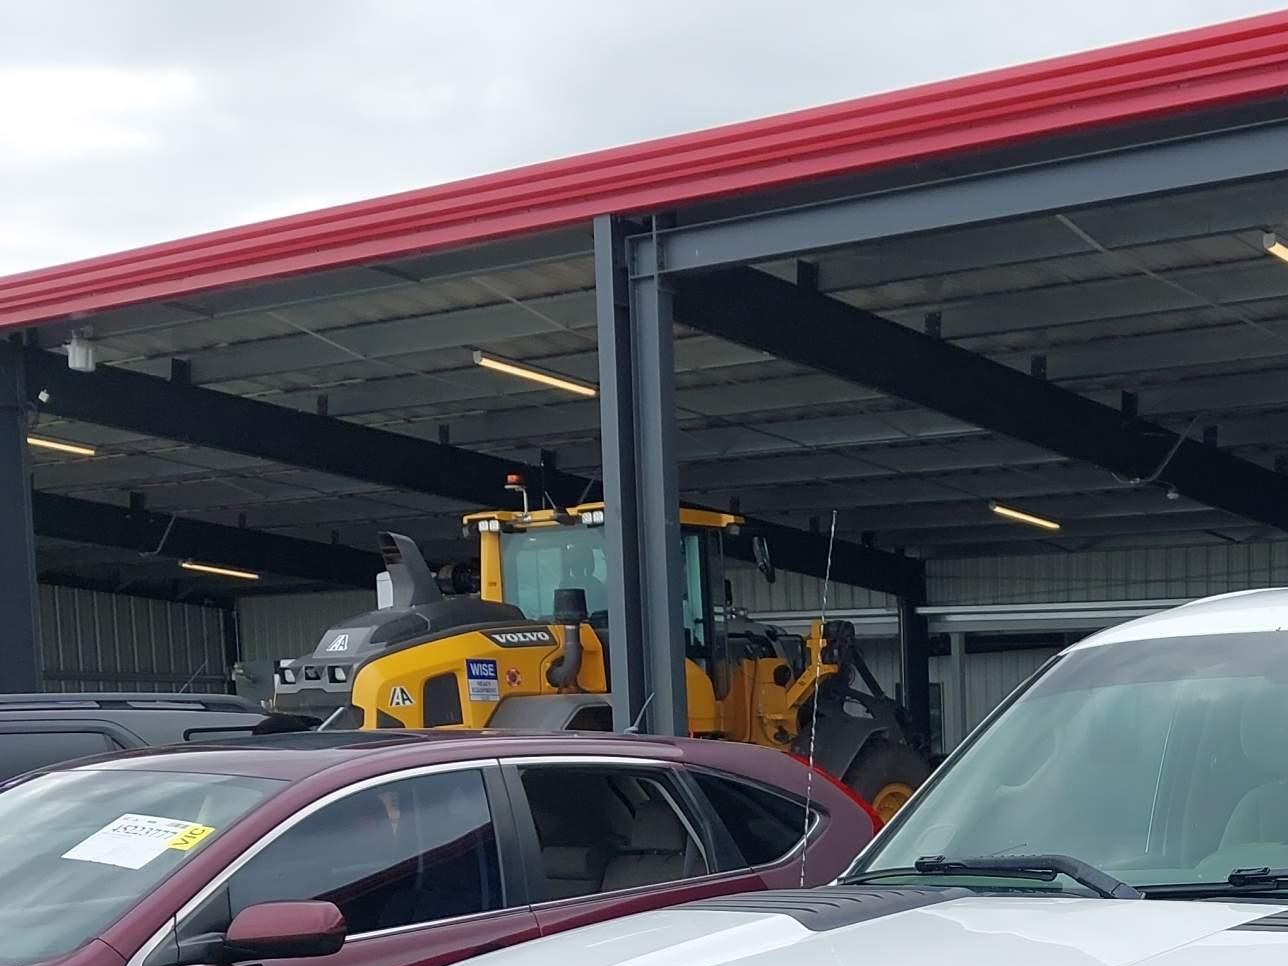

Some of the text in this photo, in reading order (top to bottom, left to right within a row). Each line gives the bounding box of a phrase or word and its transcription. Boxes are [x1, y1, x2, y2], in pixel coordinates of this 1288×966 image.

[491, 631, 550, 643] VOLVO
[469, 662, 496, 677] WISE
[172, 827, 206, 846] VIC
